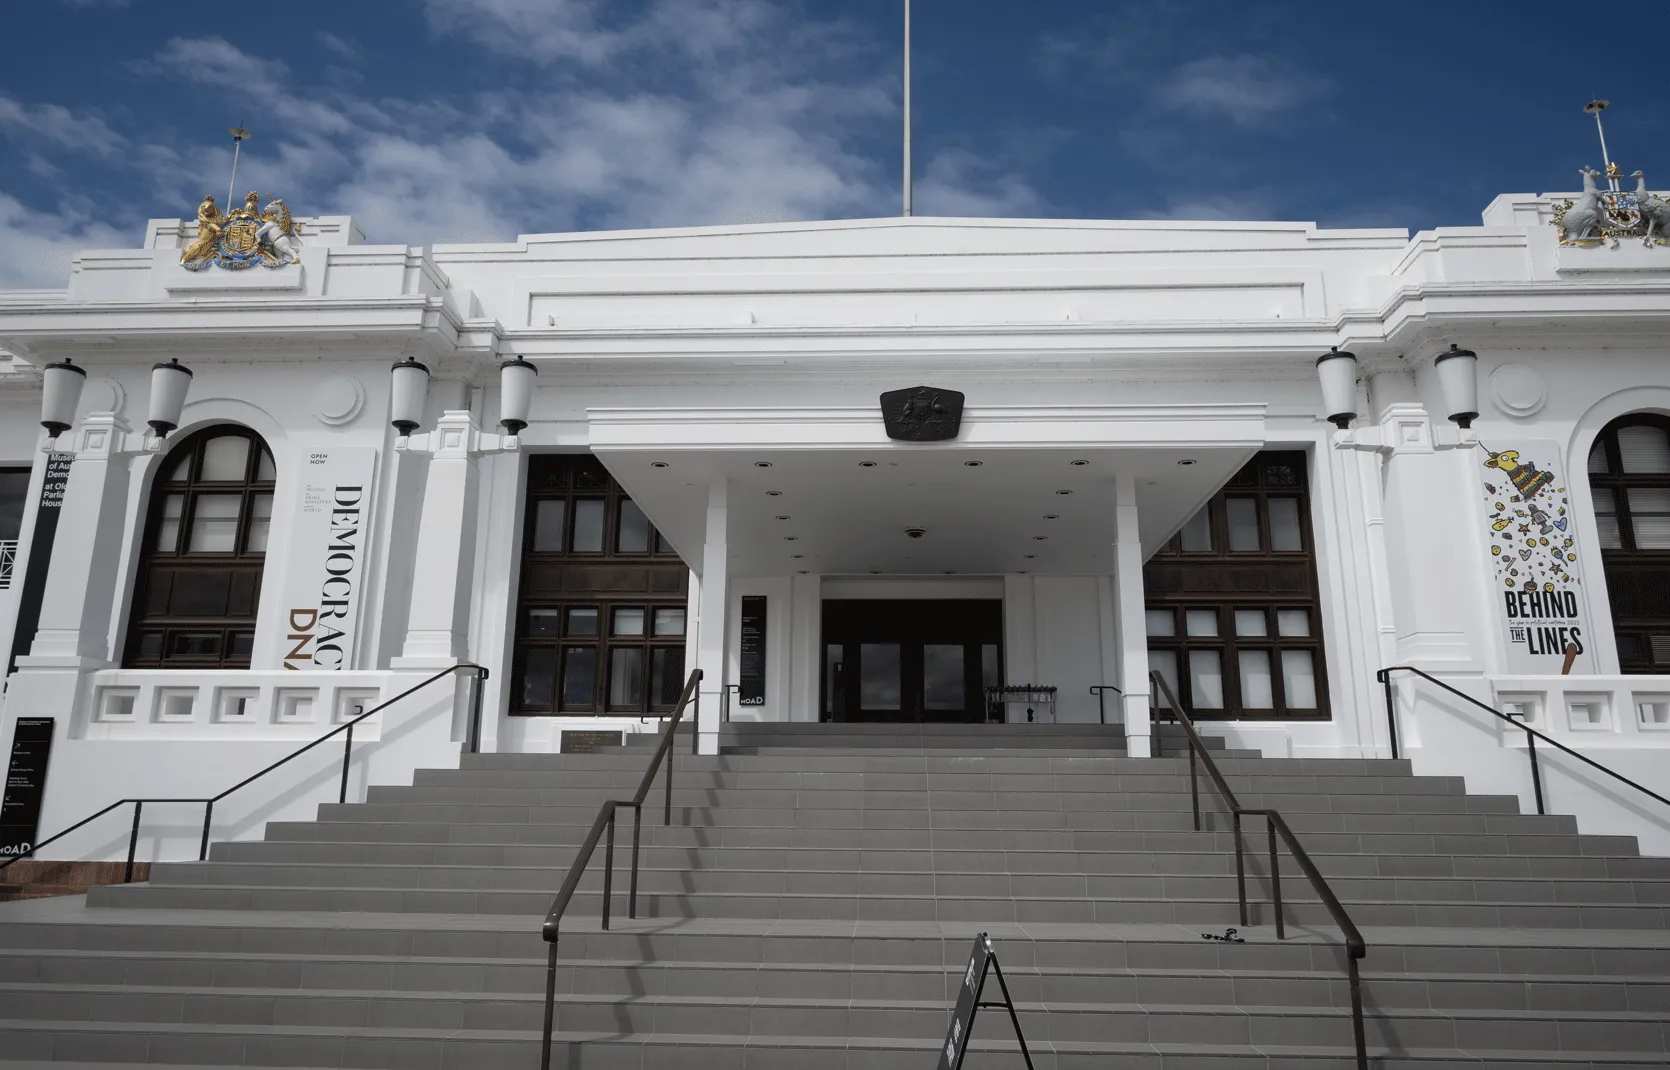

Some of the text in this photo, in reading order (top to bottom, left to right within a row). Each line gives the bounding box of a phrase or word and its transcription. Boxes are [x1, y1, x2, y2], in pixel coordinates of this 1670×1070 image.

[49, 462, 57, 470] of
[314, 484, 363, 670] DEMOCRAC
[1504, 591, 1578, 618] BEHIND
[1510, 627, 1584, 655] THE LINES
[740, 696, 764, 705] MOAD
